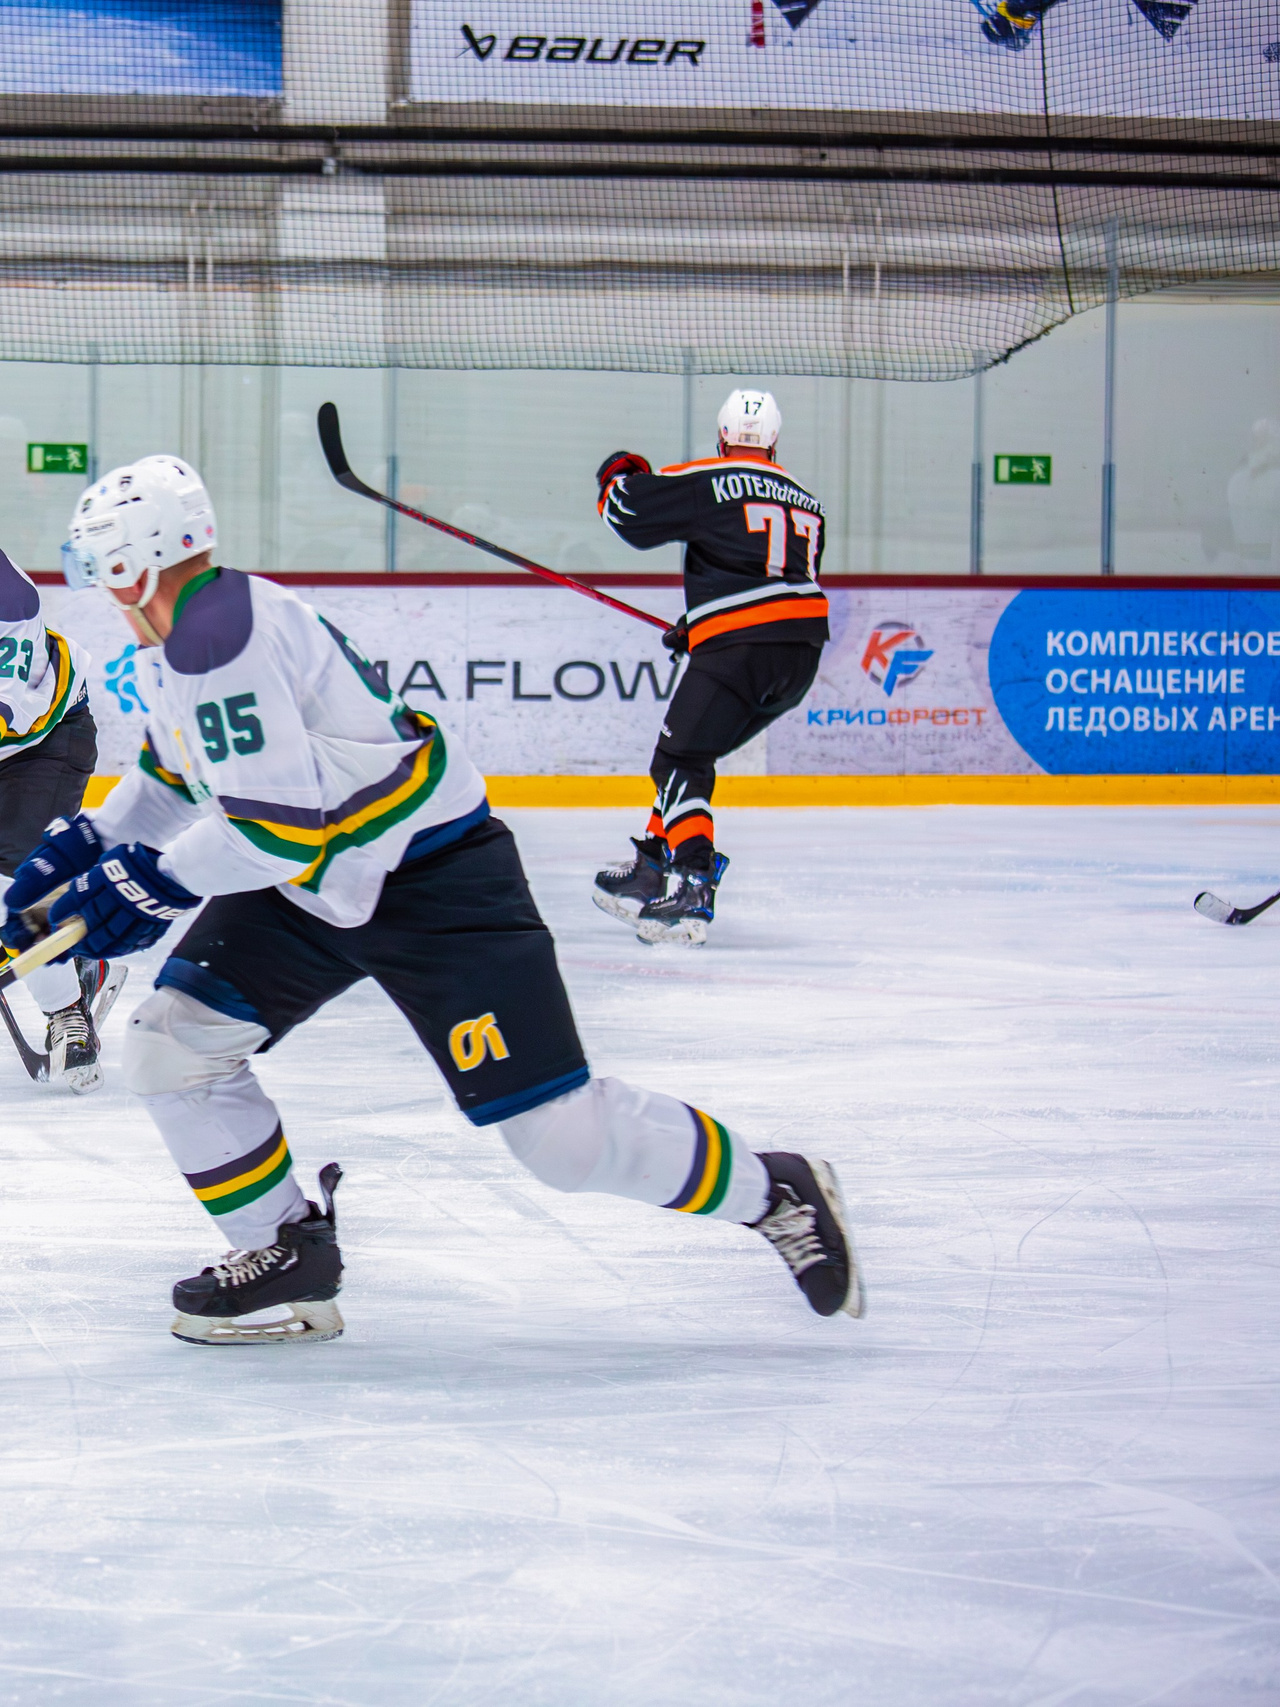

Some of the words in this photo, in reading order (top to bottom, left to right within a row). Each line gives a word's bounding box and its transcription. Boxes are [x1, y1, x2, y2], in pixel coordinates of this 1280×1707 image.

[504, 36, 706, 67] BAUER
[744, 400, 762, 416] 17
[743, 503, 821, 581] 77
[1046, 630, 1280, 657] КОМПЛЕКСНОЕ
[467, 660, 680, 701] FLOW
[1045, 668, 1245, 700] ОСНАЩЕНИЕ
[196, 692, 265, 763] 95
[807, 709, 987, 726] КРИОФРОСТ
[1045, 706, 1199, 738] ЛЕДОВЫХ
